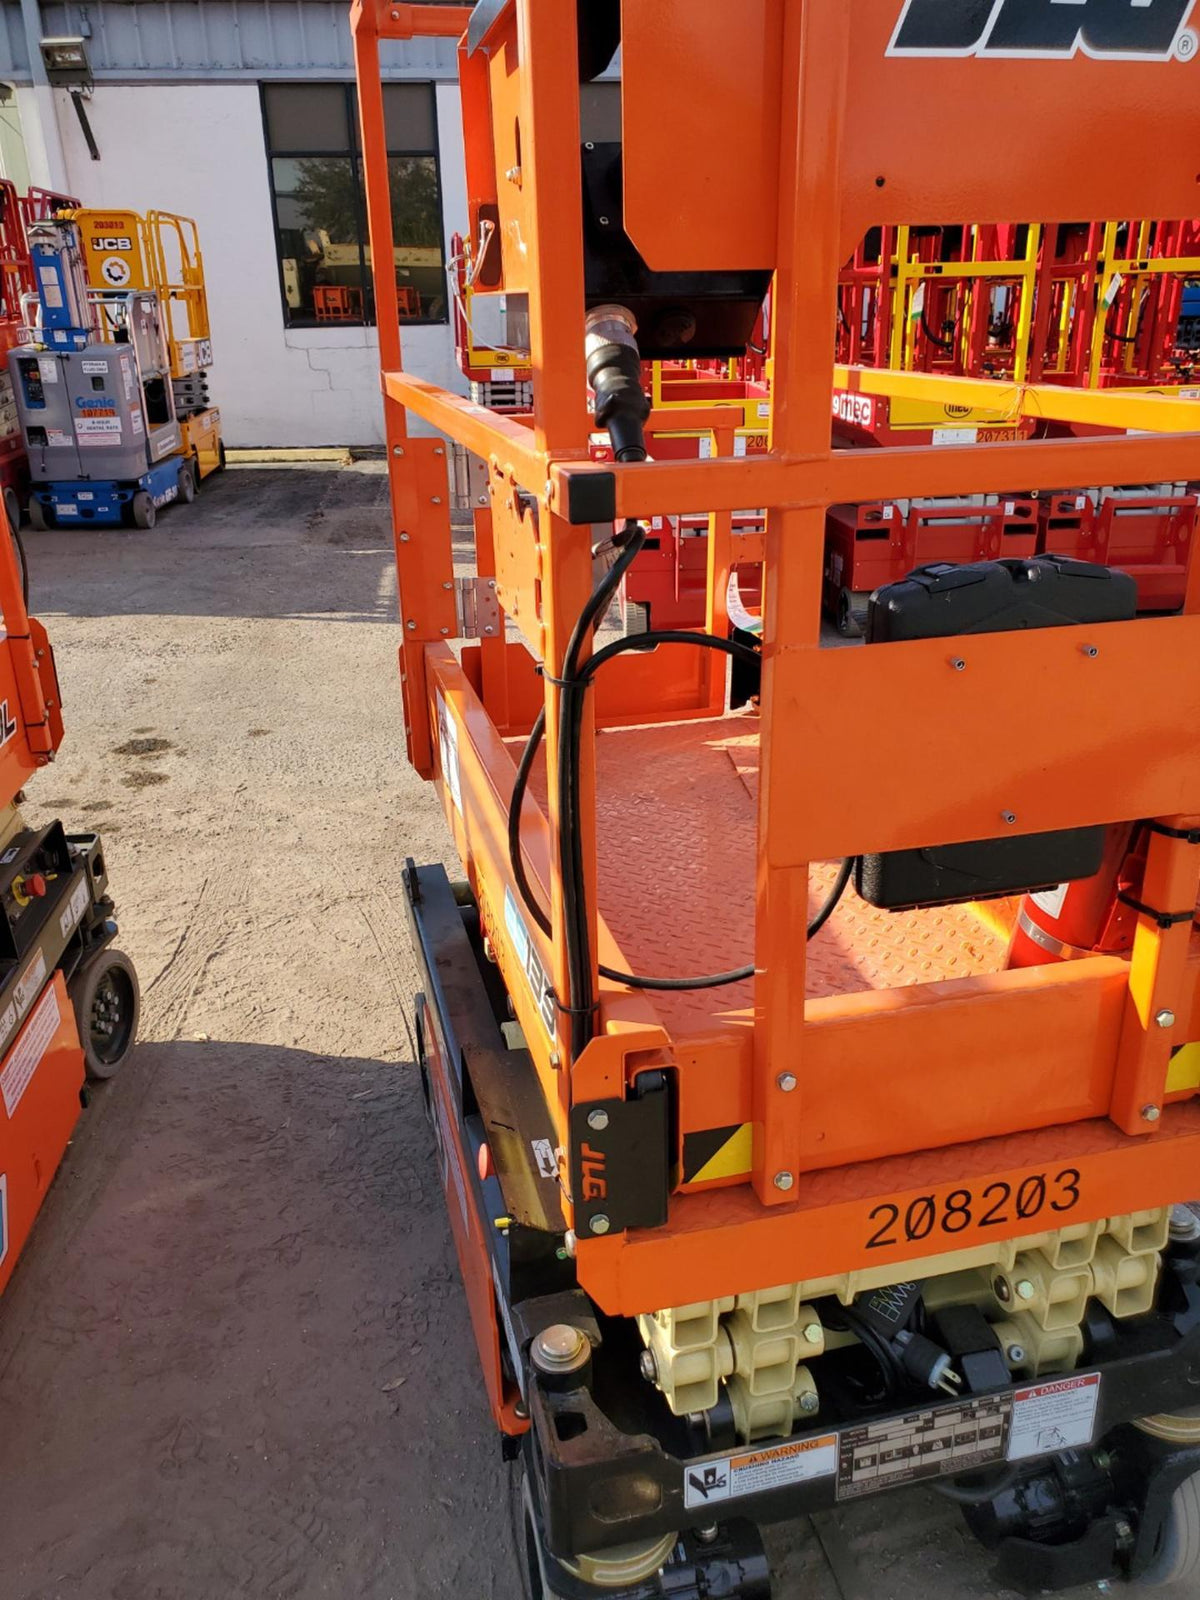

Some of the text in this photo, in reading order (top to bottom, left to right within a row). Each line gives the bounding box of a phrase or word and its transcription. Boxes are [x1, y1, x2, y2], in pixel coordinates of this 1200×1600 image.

[93, 238, 132, 250] JCB
[75, 397, 115, 408] Genie
[840, 399, 870, 421] mec
[0, 700, 17, 746] L
[580, 1142, 607, 1202] JLG
[864, 1168, 1081, 1249] 208203
[1040, 1378, 1086, 1395] DANGER
[761, 1439, 819, 1460] WARNING
[771, 1453, 800, 1466] HAZARD
